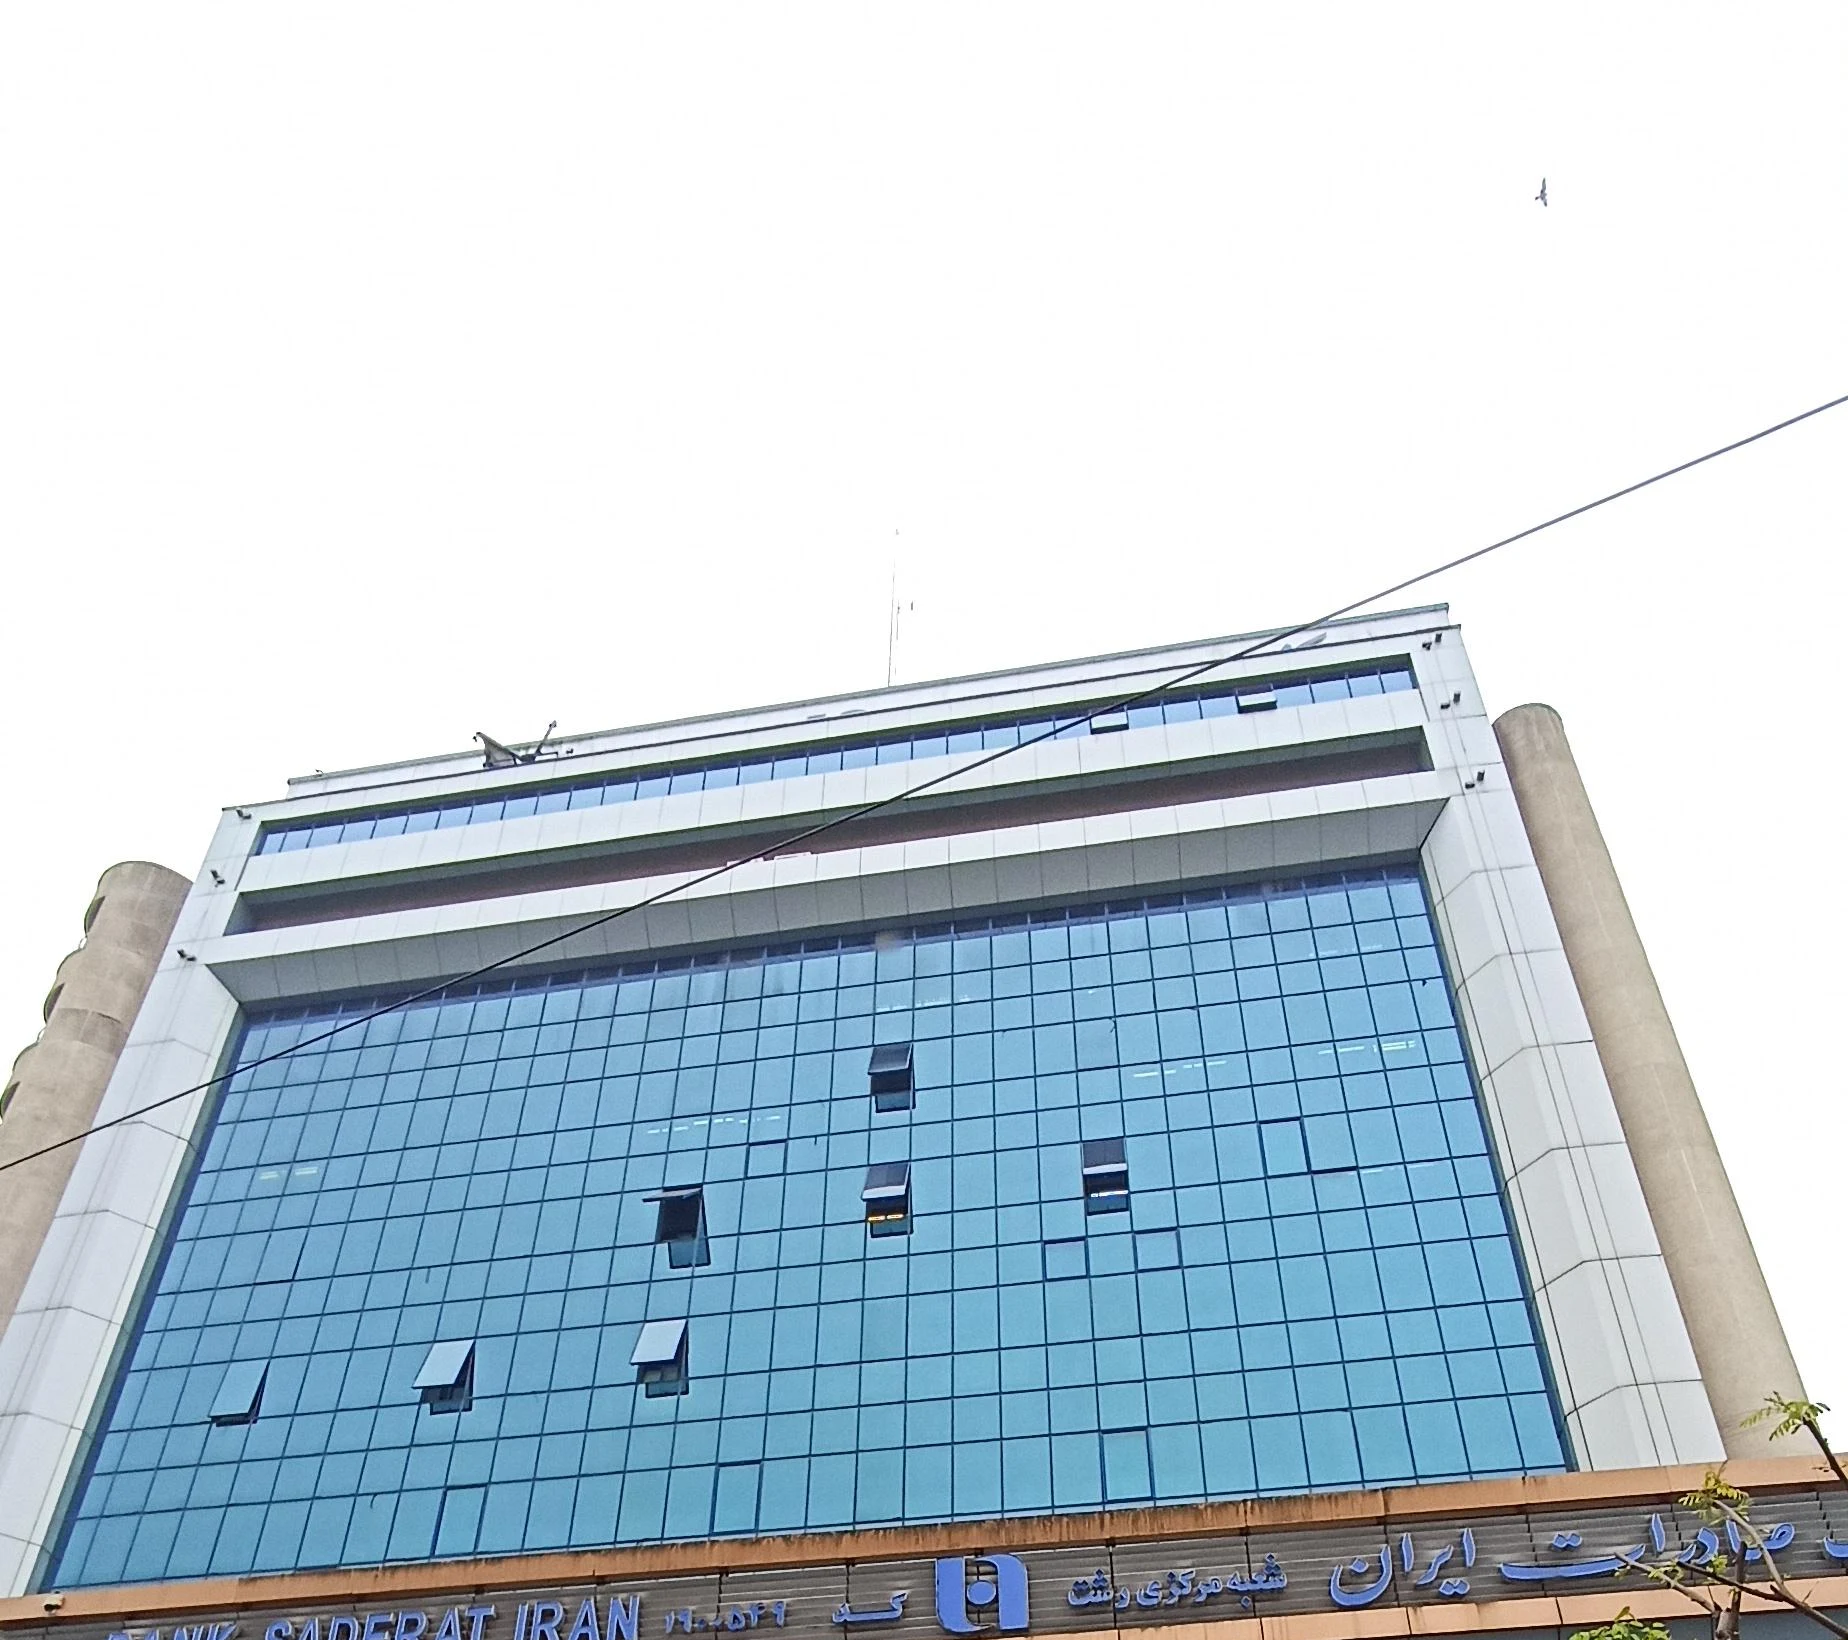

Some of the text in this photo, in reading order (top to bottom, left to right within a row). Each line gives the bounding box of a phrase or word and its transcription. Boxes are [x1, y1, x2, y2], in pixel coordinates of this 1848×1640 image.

[1067, 1552, 1288, 1609] شعبه مرکزی رشت
[1329, 1527, 1478, 1609] ایران
[832, 1590, 909, 1624] کد
